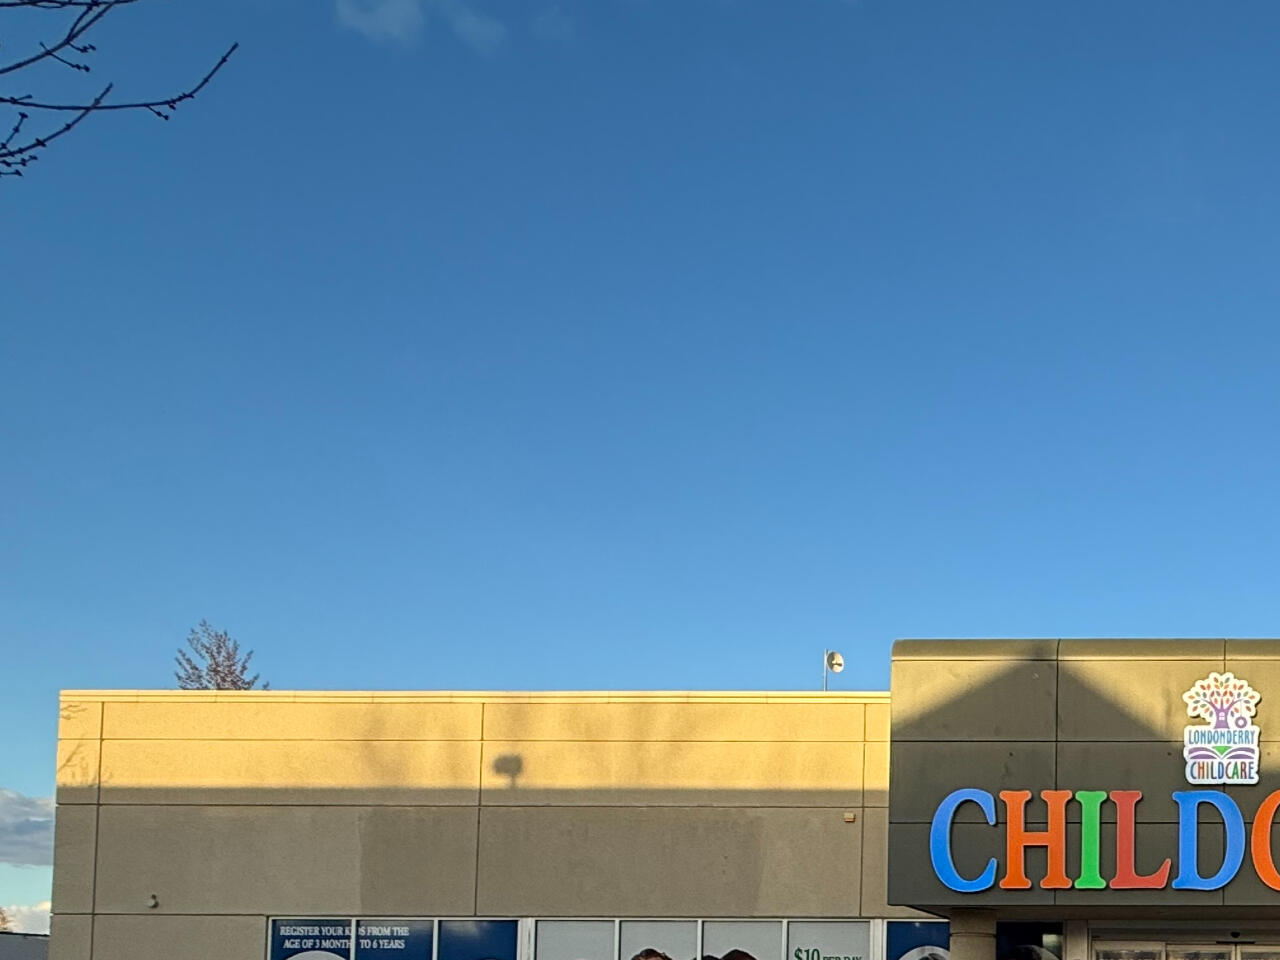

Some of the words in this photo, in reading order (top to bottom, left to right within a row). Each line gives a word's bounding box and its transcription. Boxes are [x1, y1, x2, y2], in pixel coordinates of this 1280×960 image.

[1188, 729, 1256, 745] LONDONDERRY
[1189, 761, 1255, 780] CHILDCARE
[280, 926, 319, 936] REGISTER
[321, 926, 344, 936] YOUR
[345, 926, 366, 936] KS
[367, 926, 391, 937] FROM
[392, 926, 410, 937] THE
[283, 939, 300, 949] AGE
[301, 939, 314, 949] OF
[315, 939, 320, 949] 3
[321, 939, 351, 949] MONTH
[359, 939, 372, 949] TO
[372, 939, 378, 949] 6
[379, 939, 405, 949] YEARS
